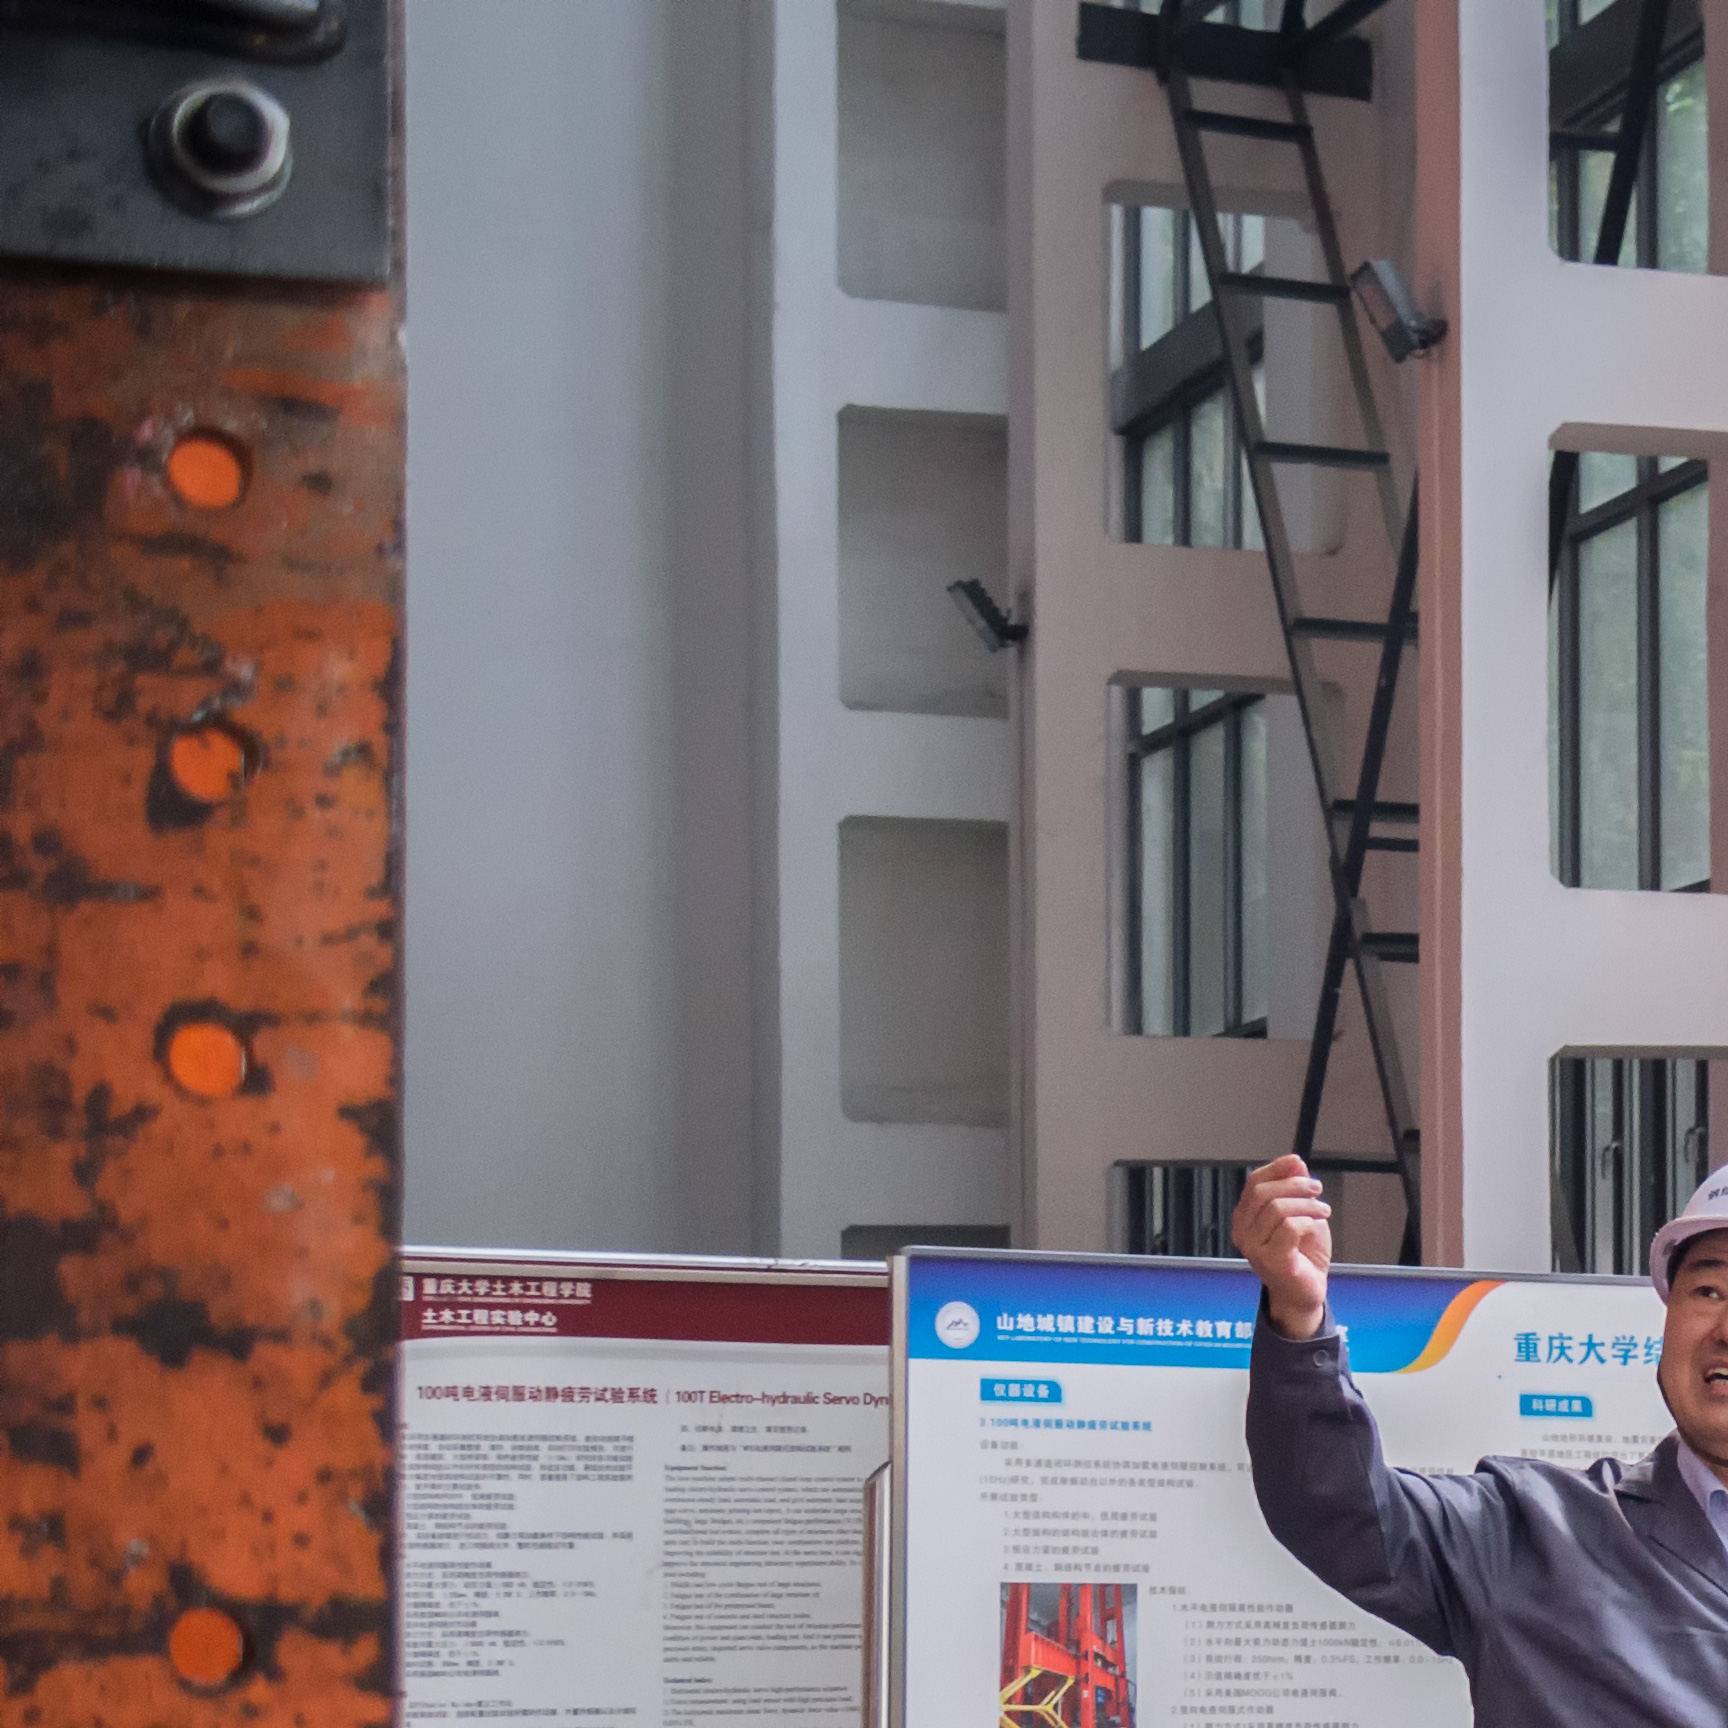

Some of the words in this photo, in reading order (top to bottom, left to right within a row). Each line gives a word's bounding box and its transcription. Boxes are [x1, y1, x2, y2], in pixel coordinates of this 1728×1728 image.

[422, 1277, 592, 1298] 重庆大学土木工程学院
[422, 1308, 558, 1327] 土木工程实验中心
[996, 1313, 1252, 1339] 山地城镇建设与新技术教育部
[416, 1384, 658, 1405] 100吨电液伺服动静疲劳试验系统
[823, 1391, 860, 1406] Servo
[863, 1392, 890, 1409] Dyn
[993, 1382, 1050, 1399] 仪器设备
[1531, 1397, 1584, 1414] 科研成果
